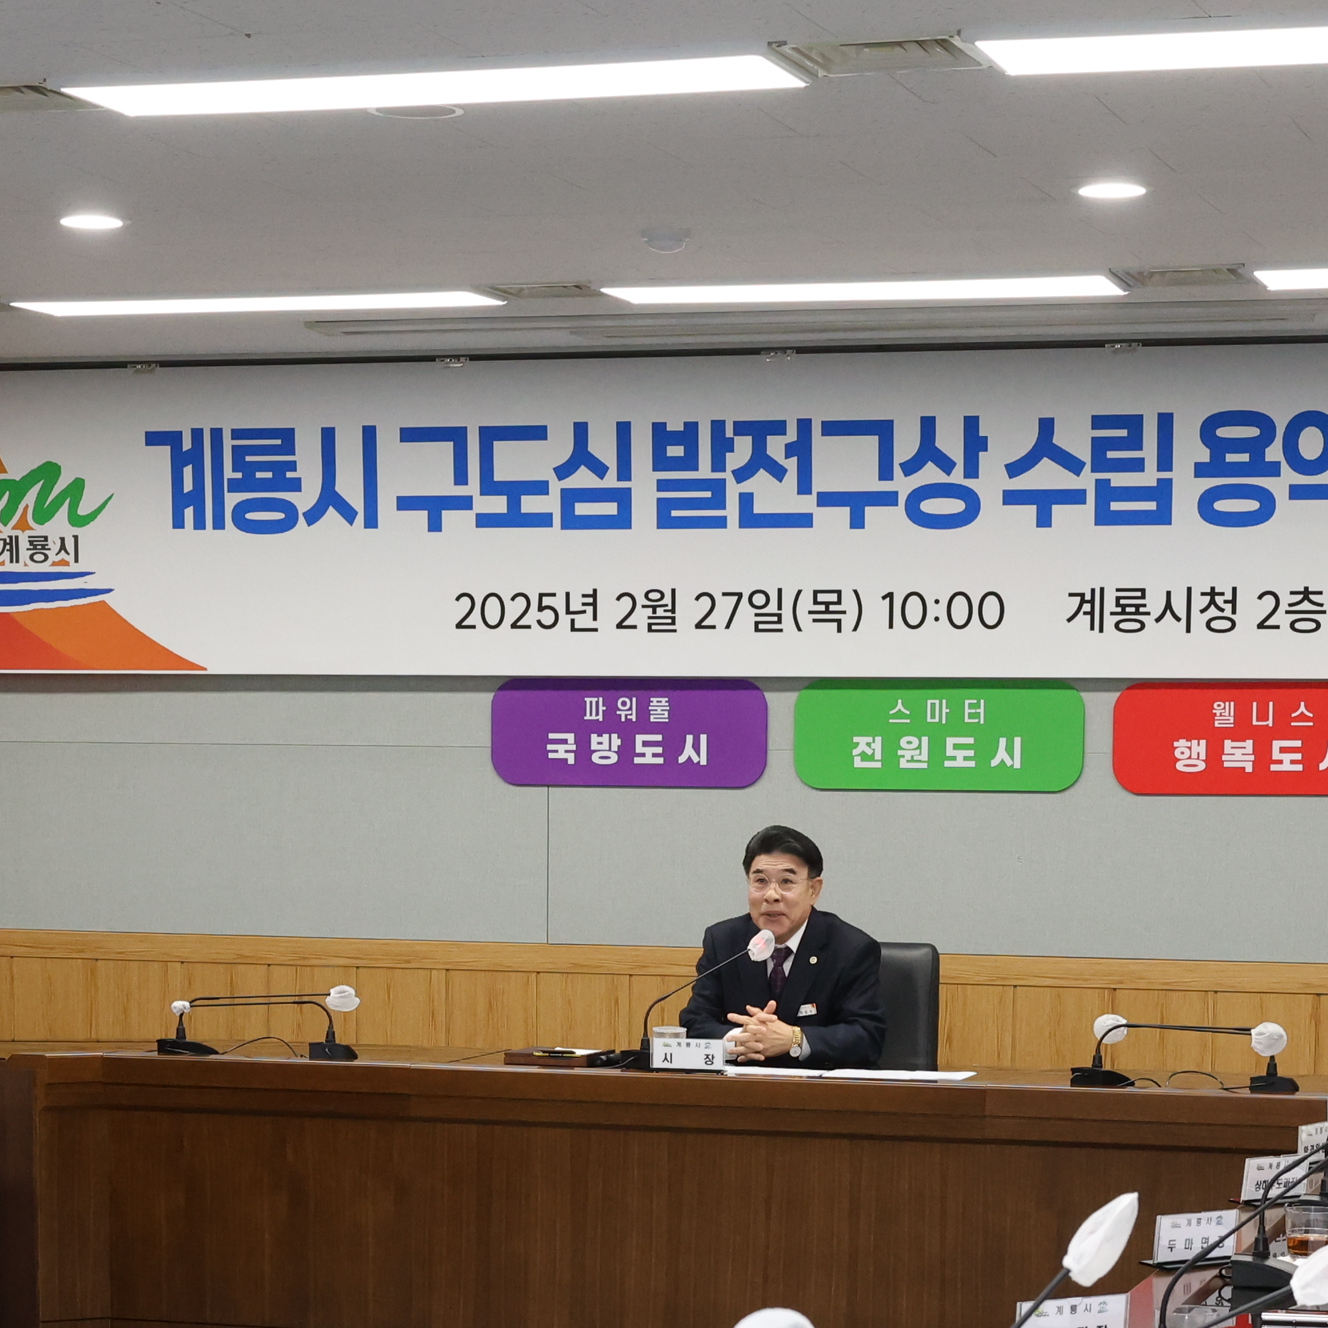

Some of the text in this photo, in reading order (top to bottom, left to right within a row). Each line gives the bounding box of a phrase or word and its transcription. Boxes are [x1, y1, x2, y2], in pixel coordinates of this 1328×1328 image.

[144, 424, 378, 535] 계룡시
[395, 420, 633, 533] 구도심
[650, 414, 989, 531] 발전구상
[1001, 411, 1174, 529] 수립
[454, 588, 600, 633] 2025년
[614, 588, 679, 634] 2월
[693, 587, 865, 636] 27일(목)
[880, 589, 1006, 632] 10:00
[1066, 586, 1239, 635] 계룡시청
[1256, 586, 1328, 635] 2층
